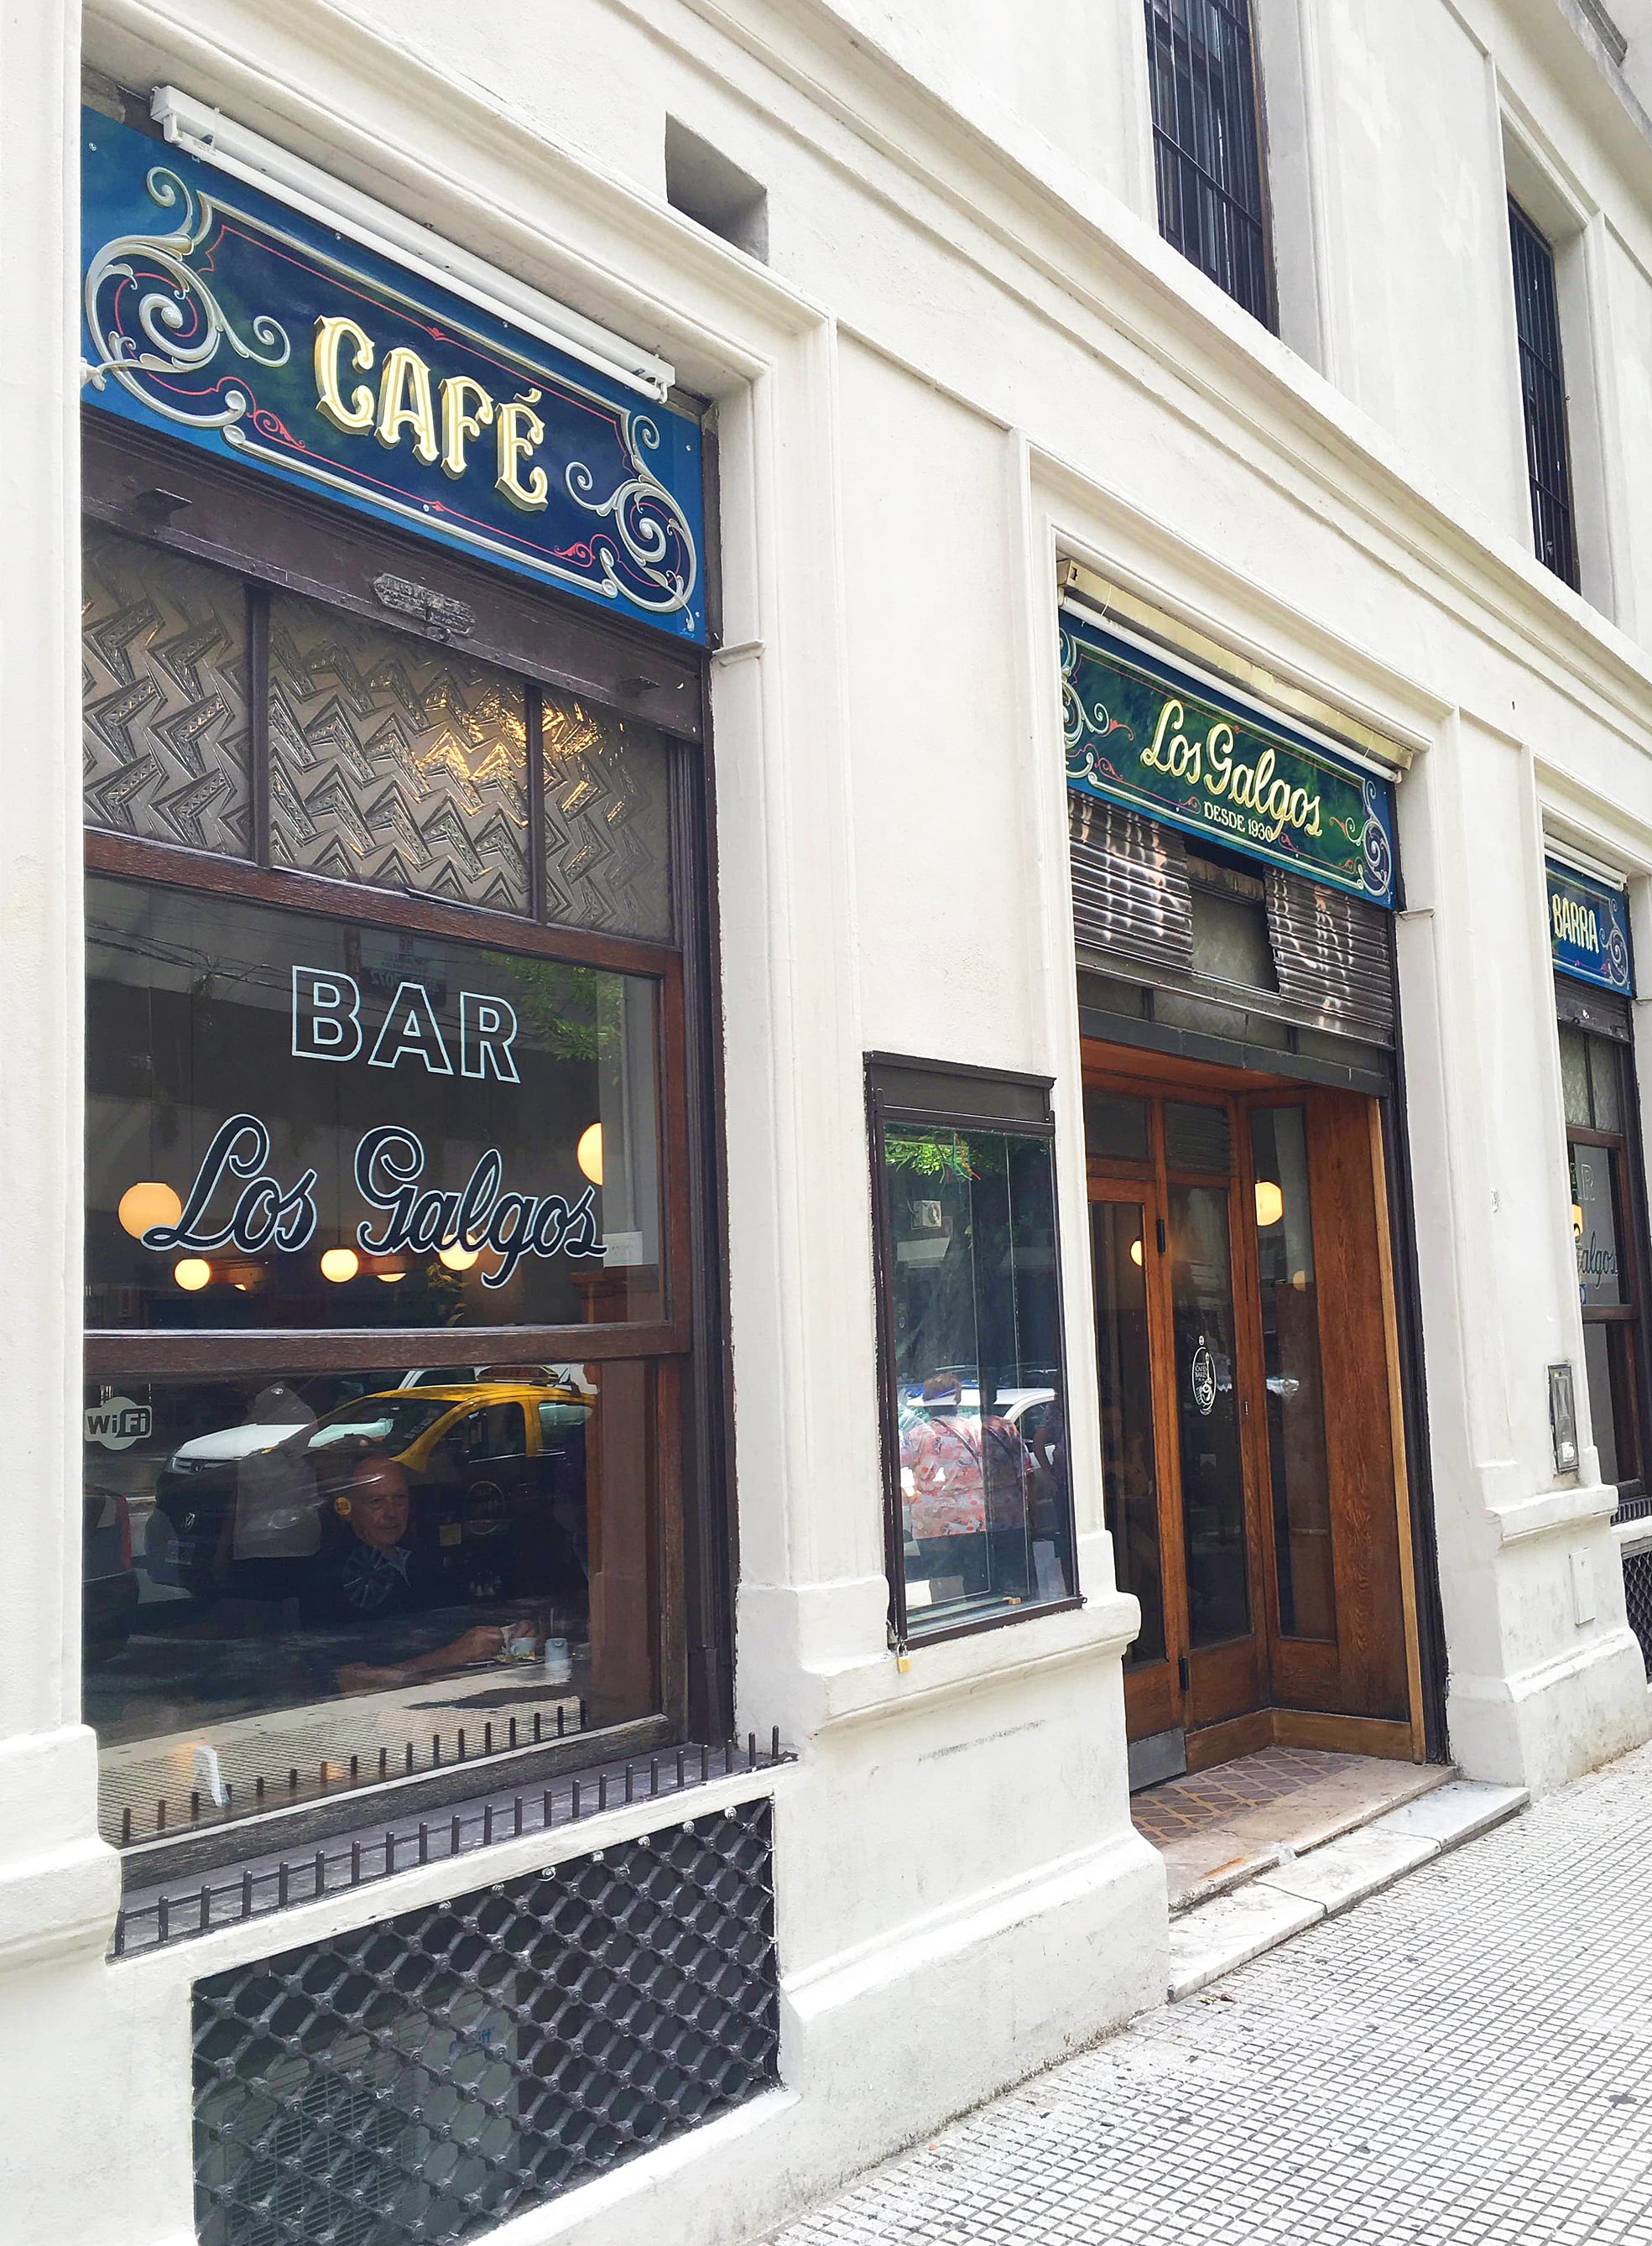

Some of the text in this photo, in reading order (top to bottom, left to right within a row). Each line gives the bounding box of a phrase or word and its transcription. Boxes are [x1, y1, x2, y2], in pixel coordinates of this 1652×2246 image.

[314, 315, 548, 508] CAFÉ
[1140, 699, 1323, 841] Los Galgos
[1204, 801, 1274, 842] DESDE 1930
[1552, 894, 1599, 953] BARRA
[293, 965, 520, 1083] BAR
[141, 1113, 607, 1289] Los Galgos
